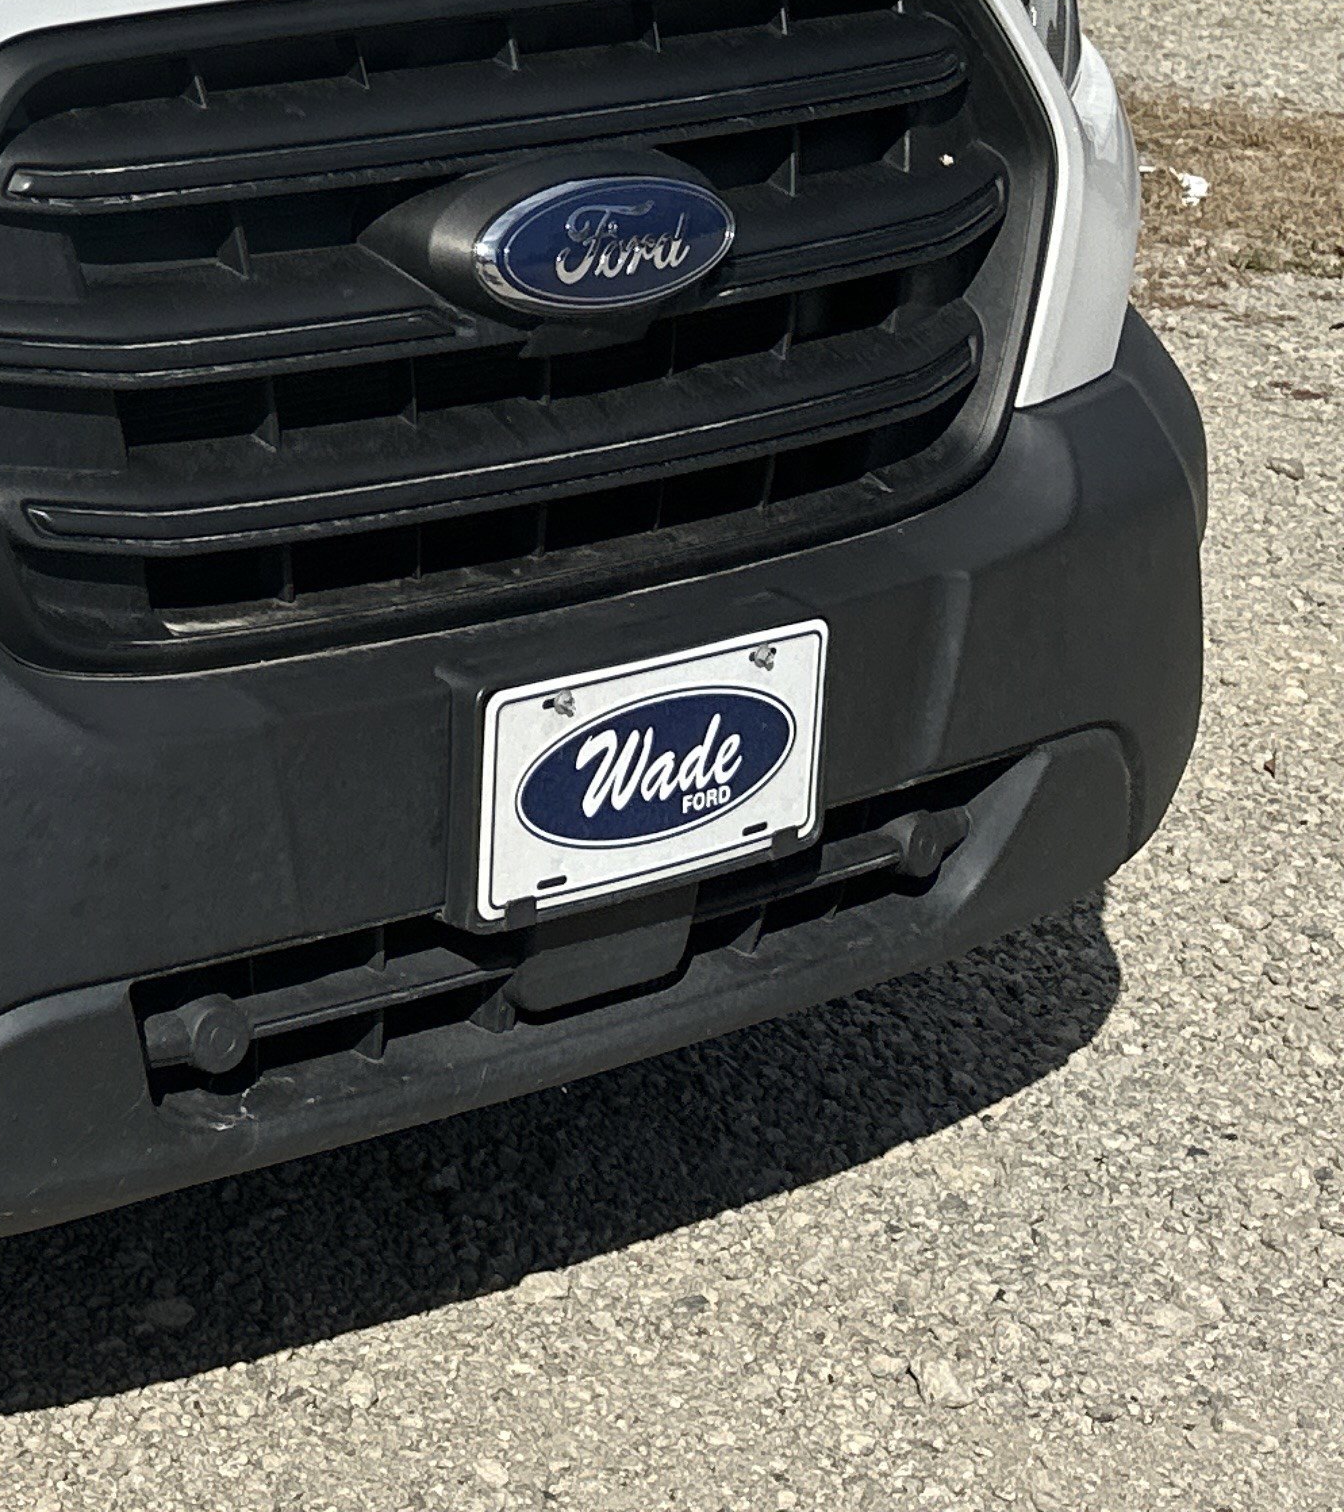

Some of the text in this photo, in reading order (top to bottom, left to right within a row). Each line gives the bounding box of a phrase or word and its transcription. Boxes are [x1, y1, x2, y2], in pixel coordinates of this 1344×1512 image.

[555, 200, 690, 285] Ford
[576, 713, 743, 818] Wade
[682, 785, 731, 814] FORD
